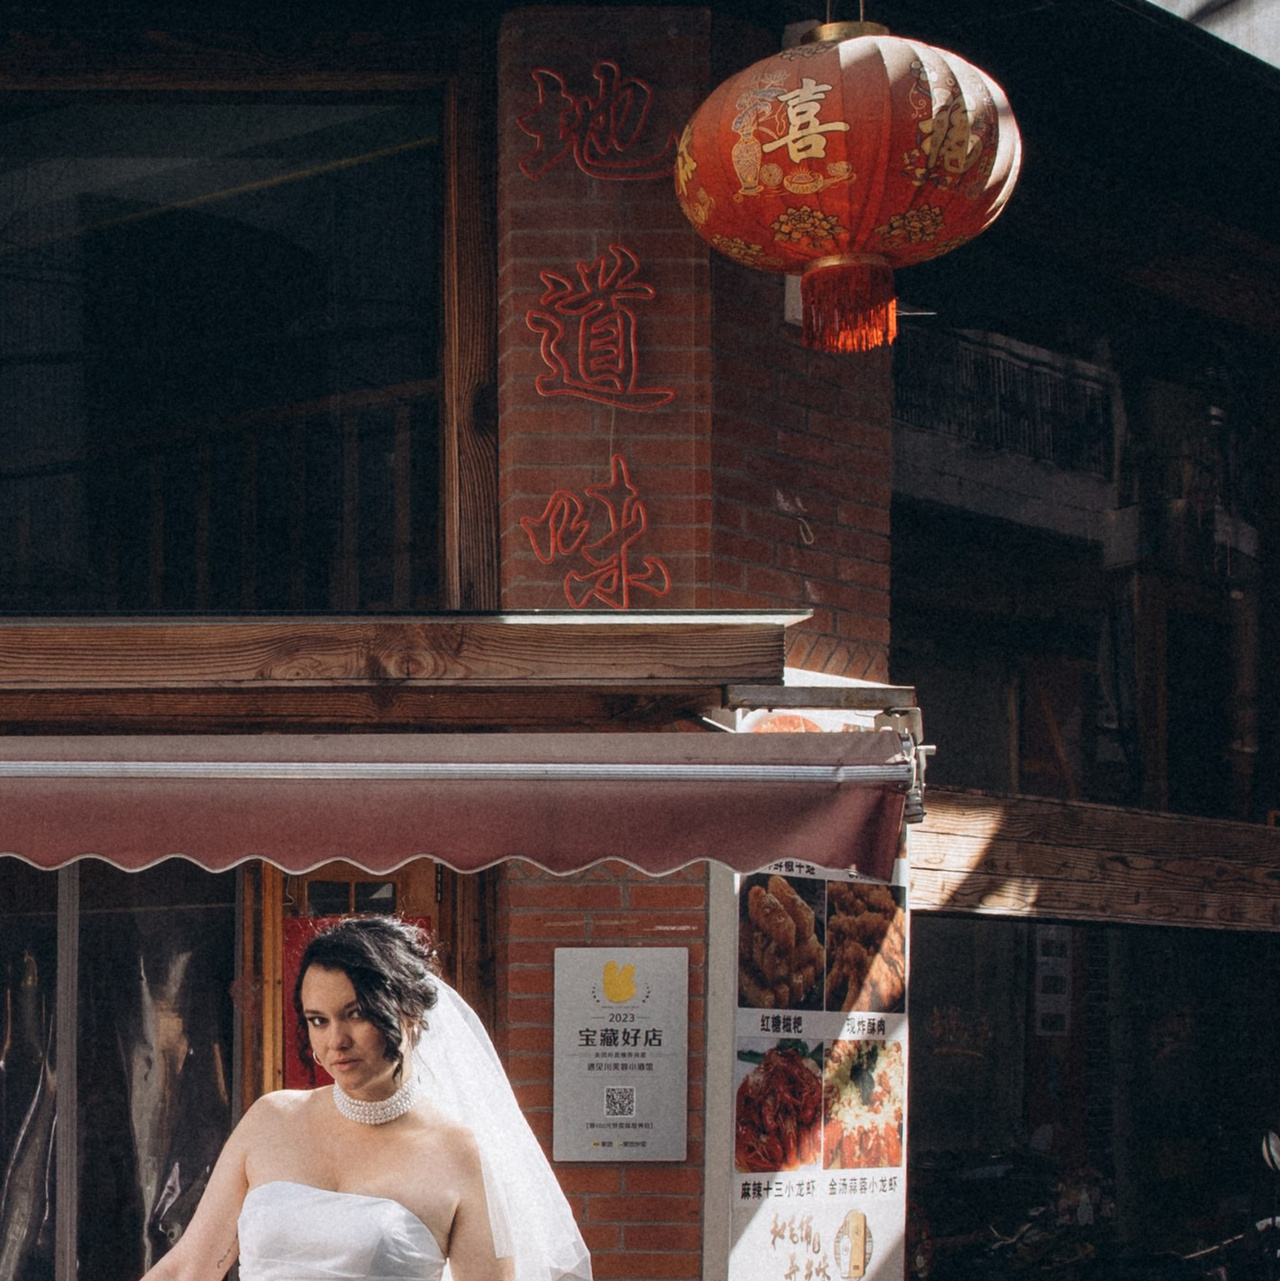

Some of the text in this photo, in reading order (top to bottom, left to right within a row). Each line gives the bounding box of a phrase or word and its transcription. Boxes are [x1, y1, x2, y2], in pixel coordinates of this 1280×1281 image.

[762, 77, 850, 164] 喜
[608, 1013, 635, 1023] 2023
[578, 1028, 663, 1047] 宝藏好店
[740, 1179, 816, 1200] 麻辣十三小龙虾
